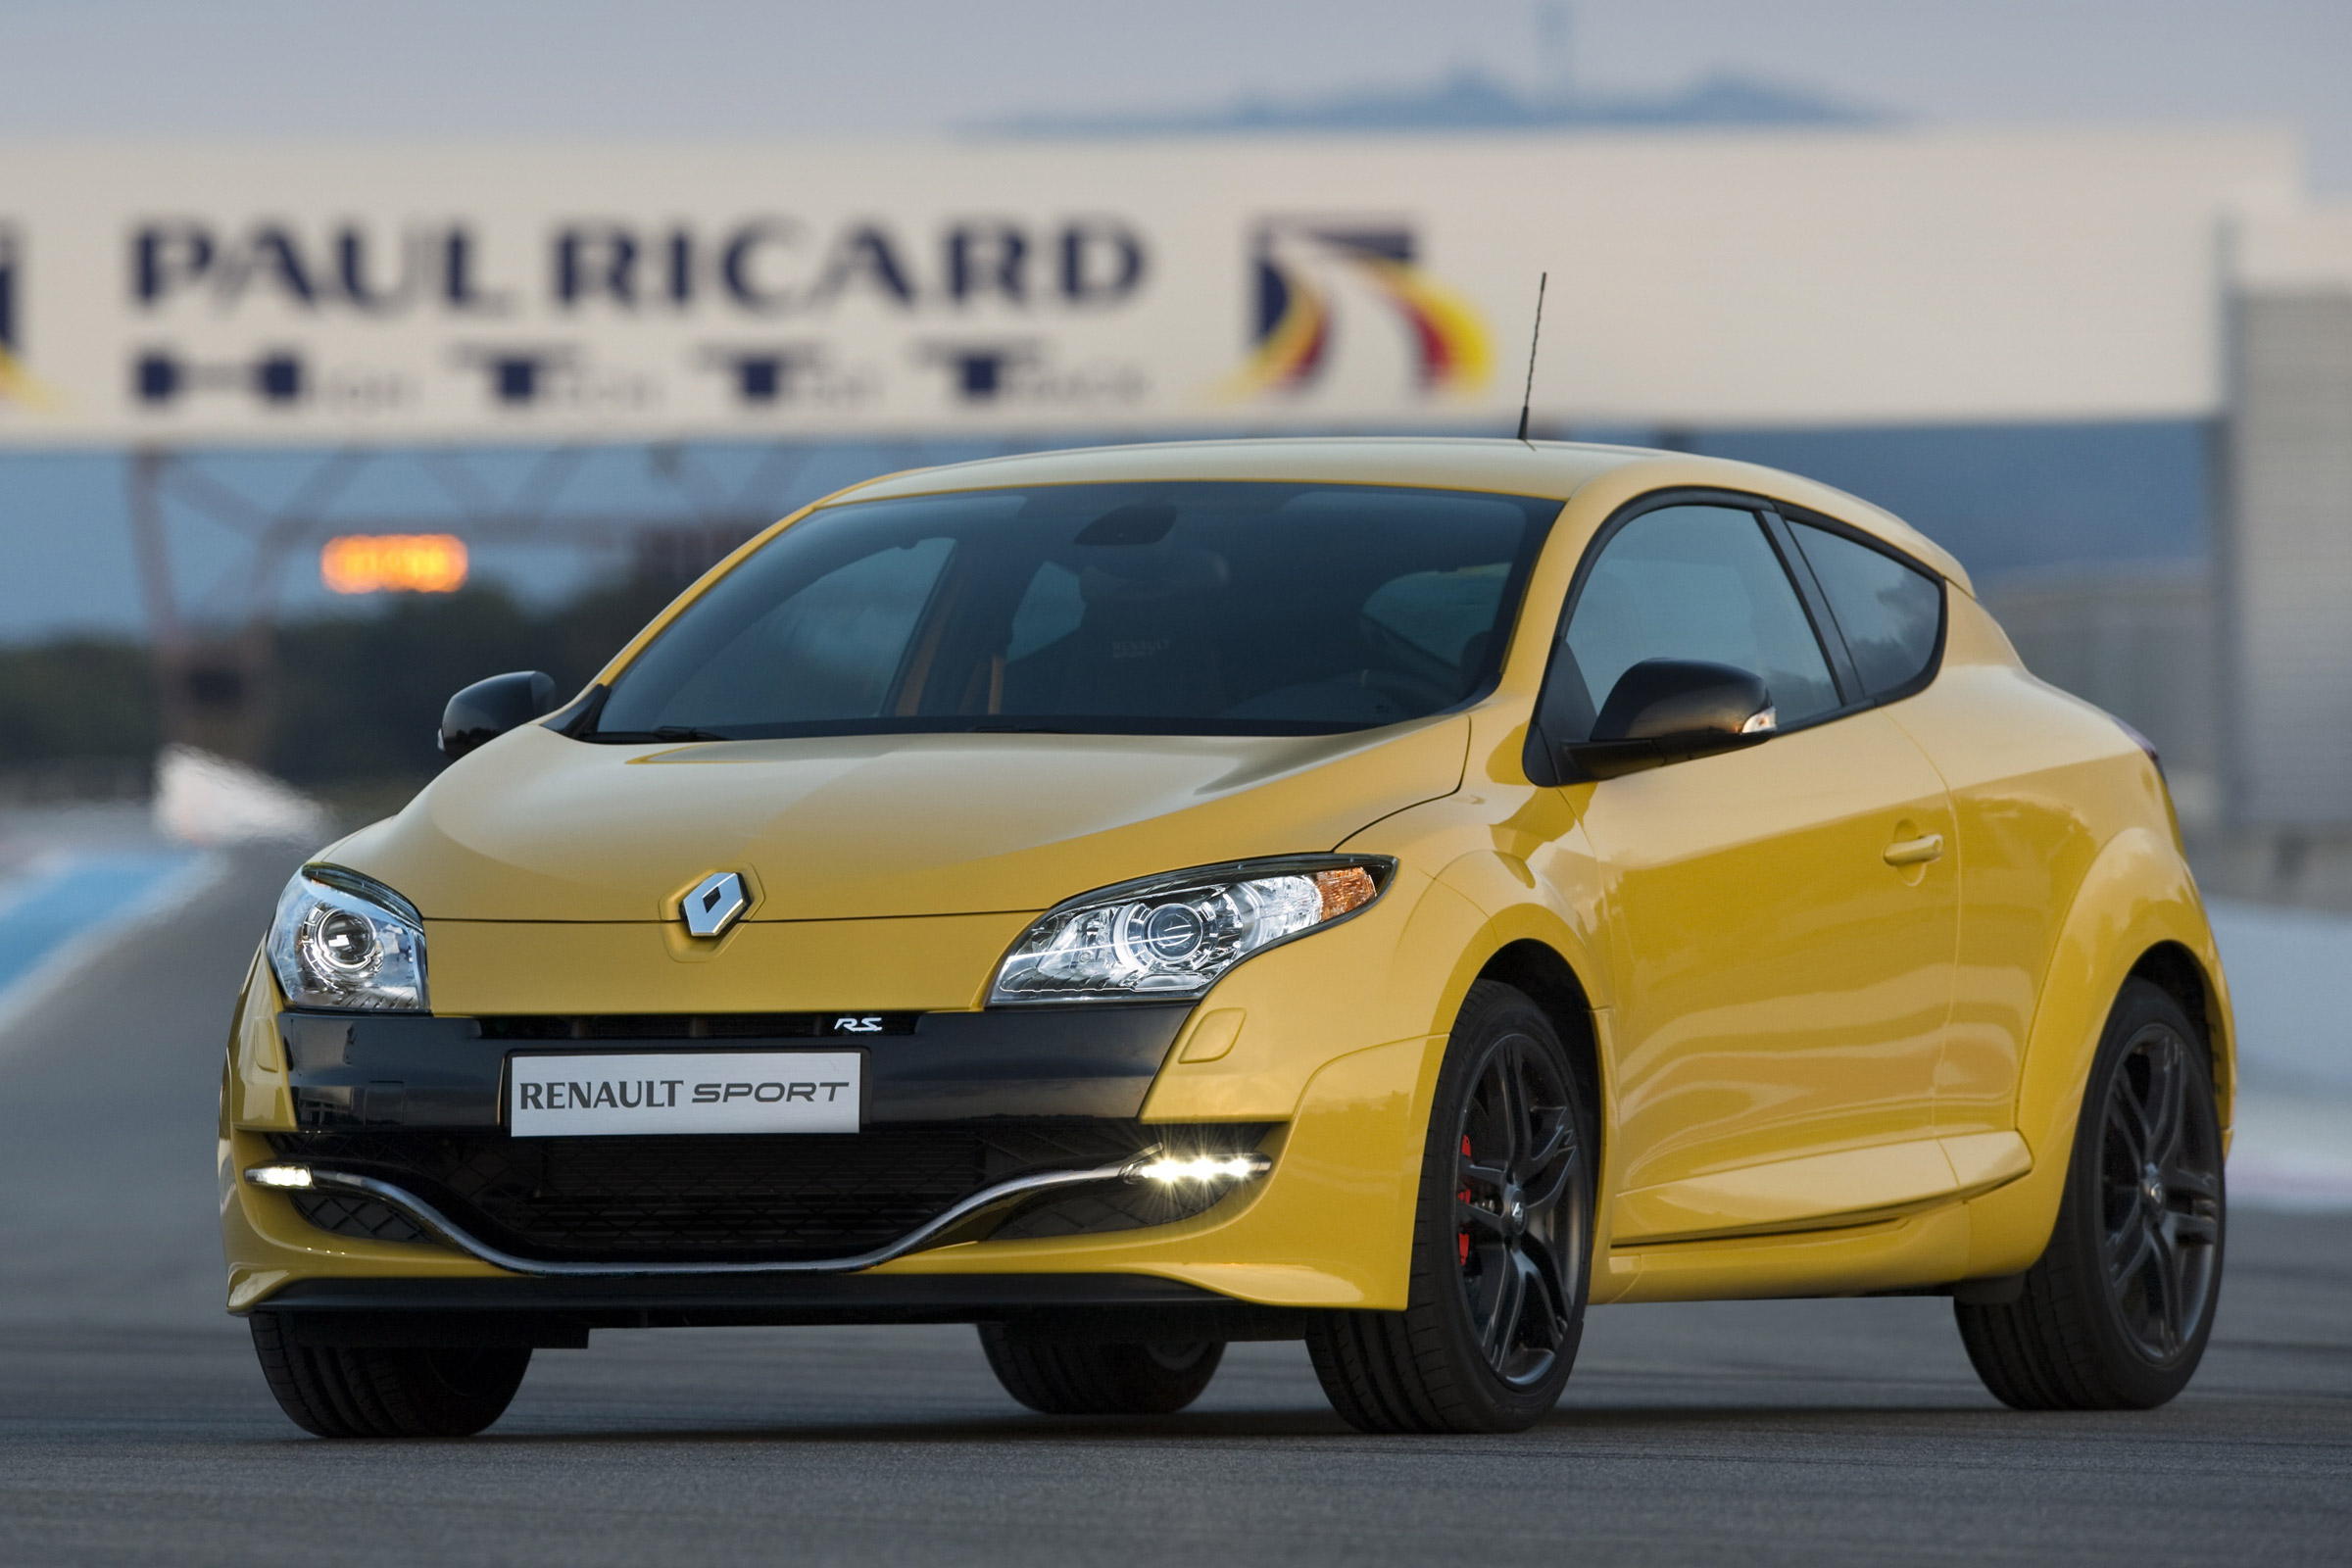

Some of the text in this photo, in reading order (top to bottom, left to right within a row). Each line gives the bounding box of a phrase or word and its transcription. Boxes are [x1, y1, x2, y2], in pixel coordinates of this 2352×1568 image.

[125, 218, 1152, 313] PAUL RICARD
[834, 1017, 883, 1032] RS
[519, 1080, 850, 1109] RENAULT SPORT
